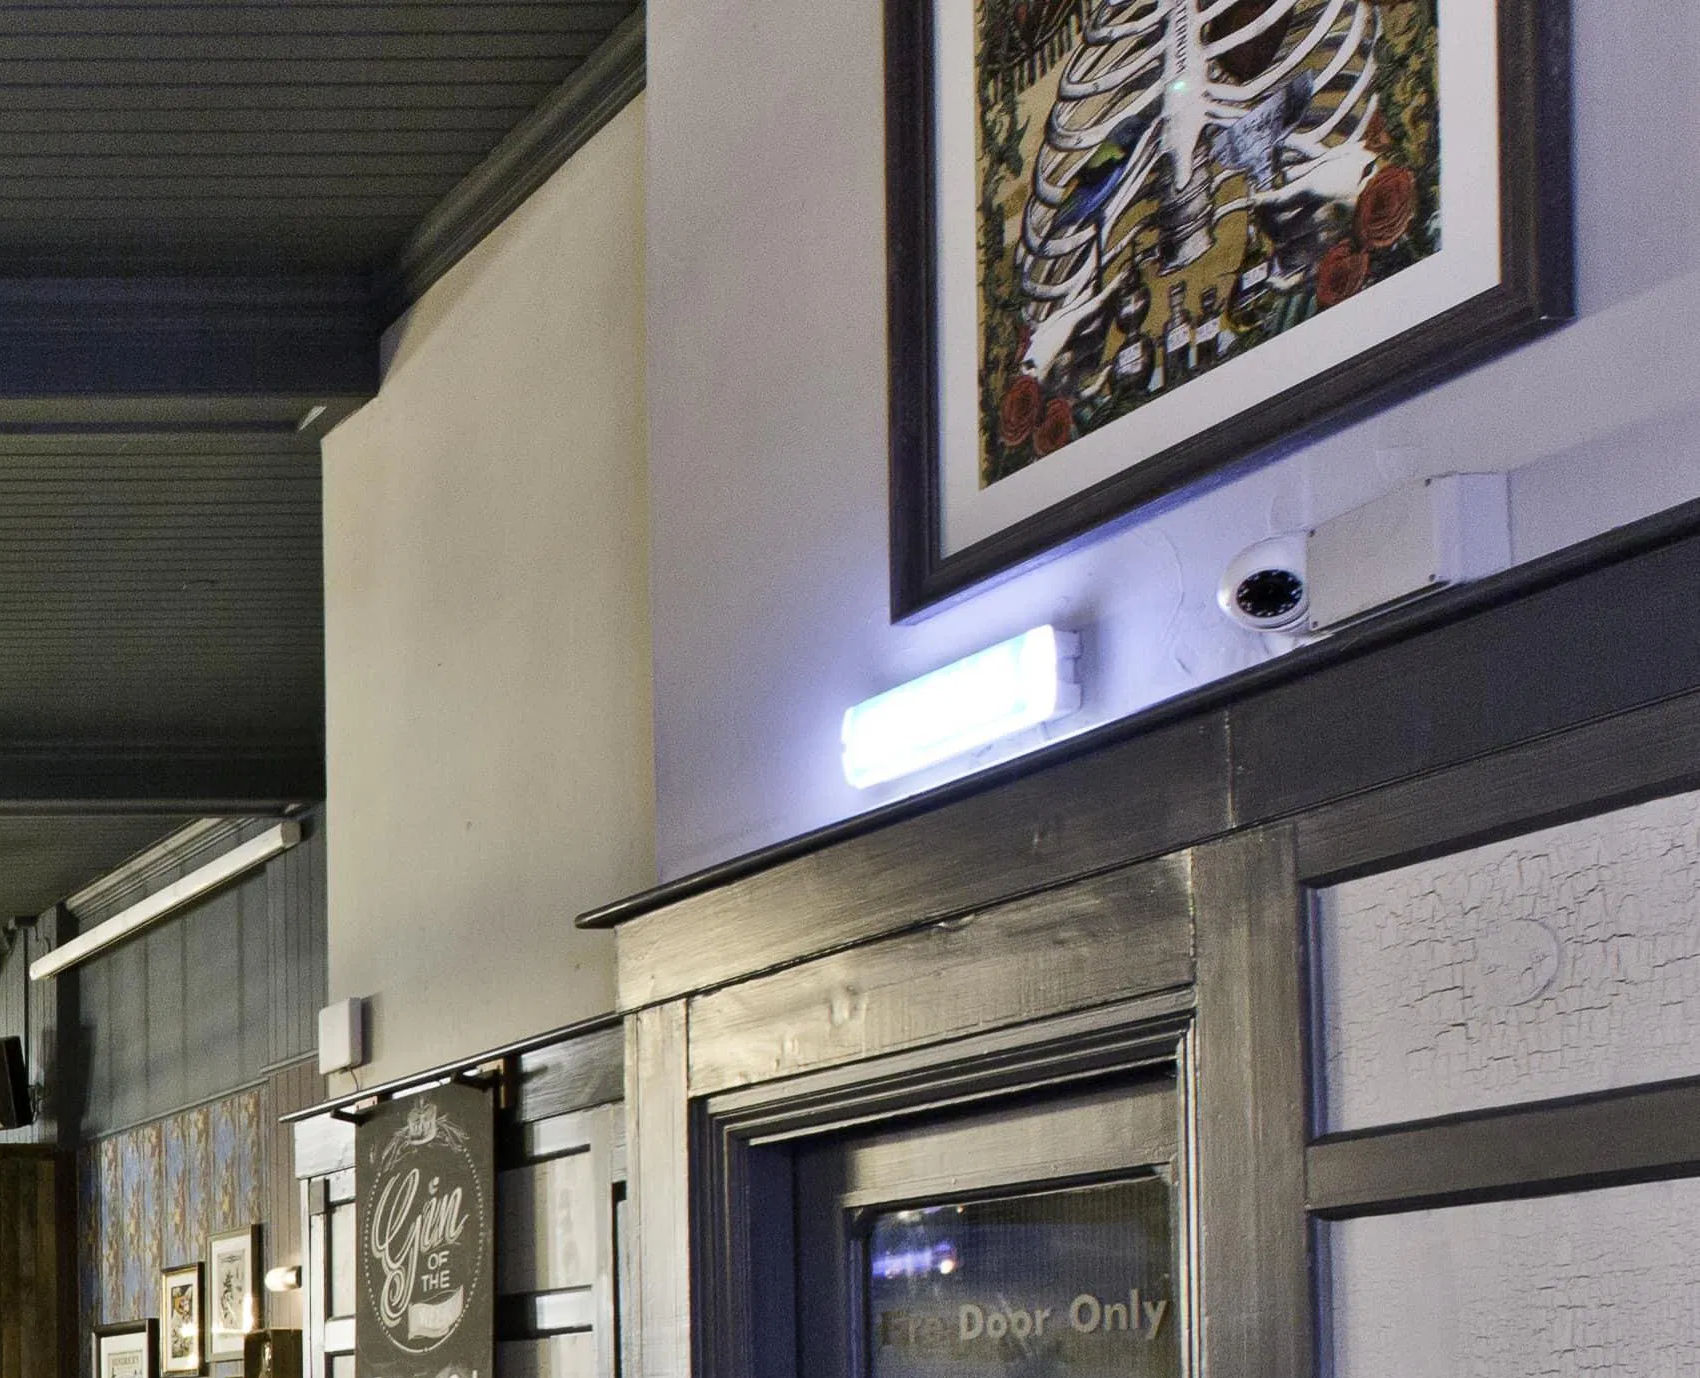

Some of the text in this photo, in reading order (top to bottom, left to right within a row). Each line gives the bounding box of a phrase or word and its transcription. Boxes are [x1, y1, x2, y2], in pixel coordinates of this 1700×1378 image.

[372, 1168, 470, 1328] Gin
[427, 1251, 449, 1270] OF
[421, 1270, 450, 1292] THE
[959, 1303, 1049, 1340] Door
[1069, 1288, 1168, 1341] Only
